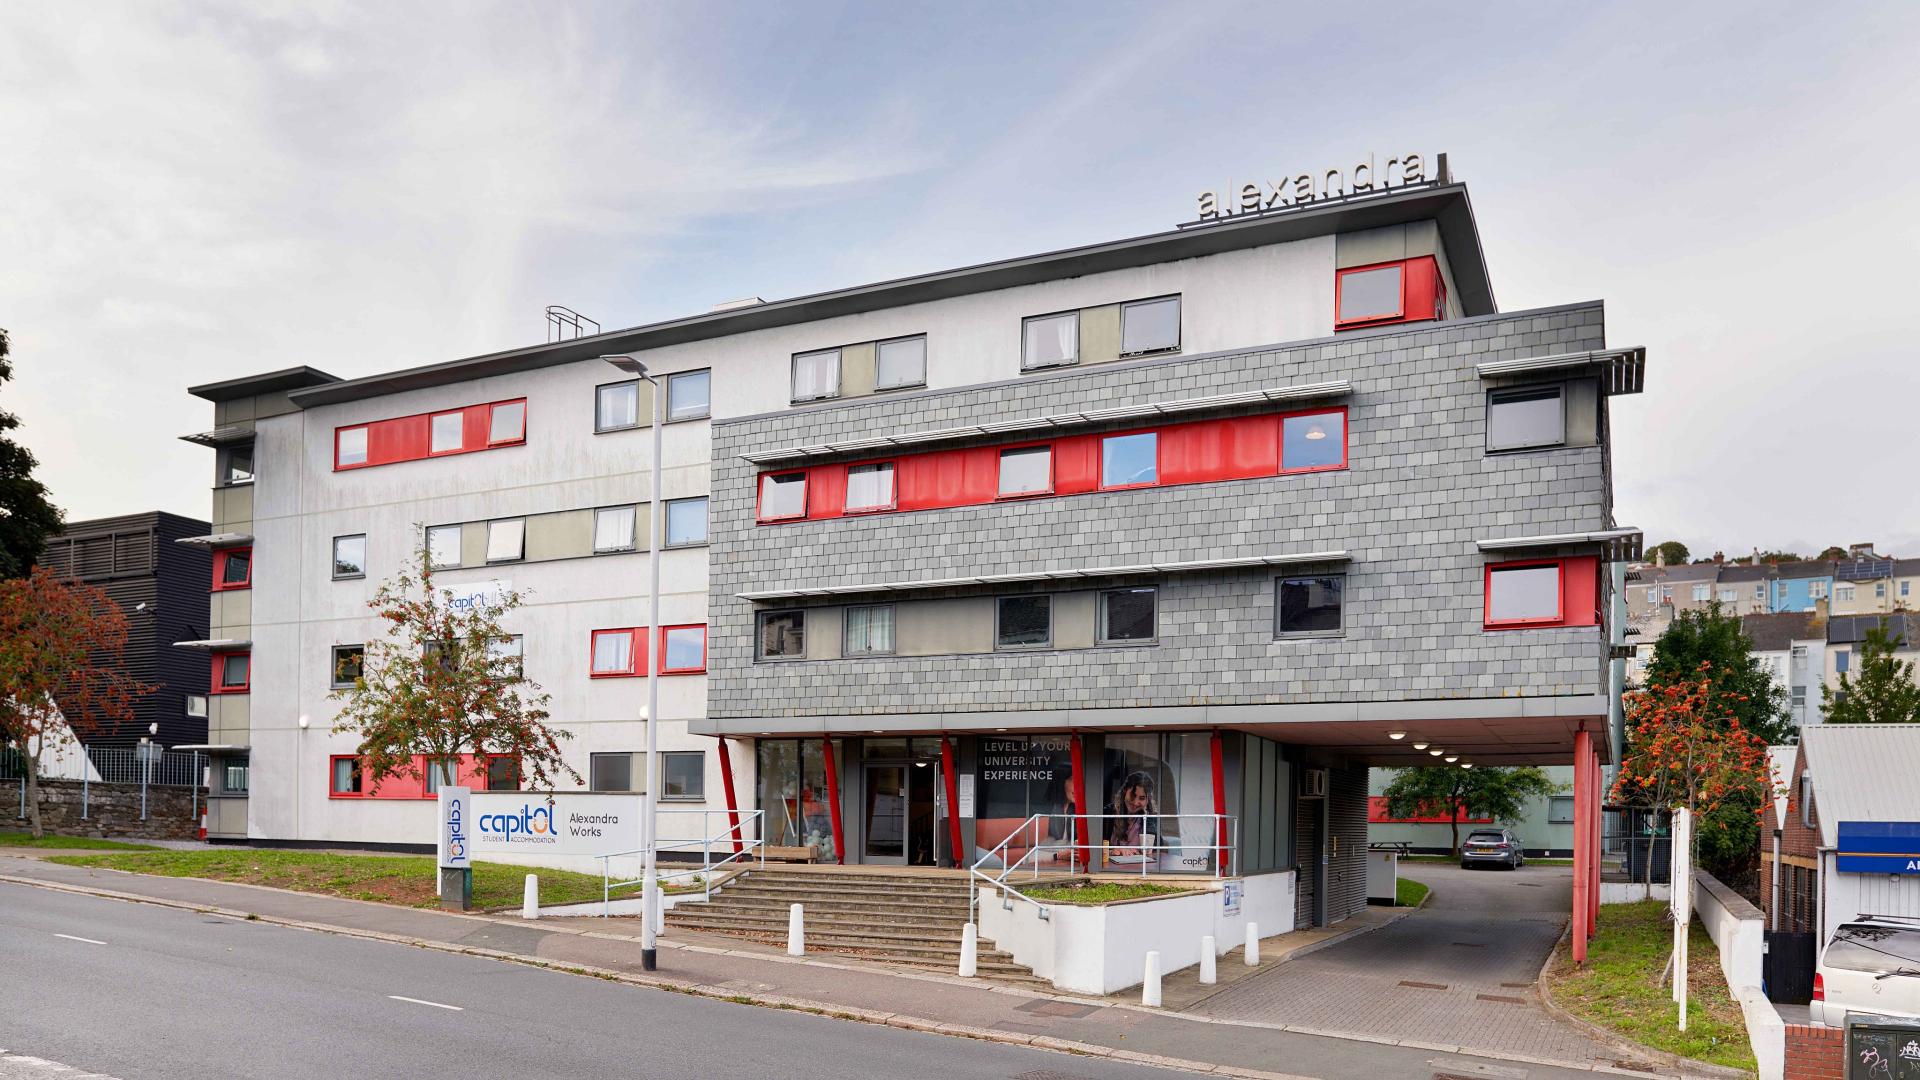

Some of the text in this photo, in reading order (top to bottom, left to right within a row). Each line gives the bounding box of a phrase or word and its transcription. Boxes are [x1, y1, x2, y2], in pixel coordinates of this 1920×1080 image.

[1198, 151, 1425, 218] alexandra
[448, 592, 486, 612] capitol
[984, 742, 1018, 752] LEVEL
[1040, 742, 1071, 752] YOUR
[984, 770, 1053, 780] EXPERIENCE
[479, 804, 558, 842] capitol
[569, 812, 619, 825] Alexandra
[447, 799, 466, 864] capitol
[569, 825, 602, 837] Works
[510, 836, 556, 844] ACCOMMODATION
[1183, 856, 1210, 868] capitol
